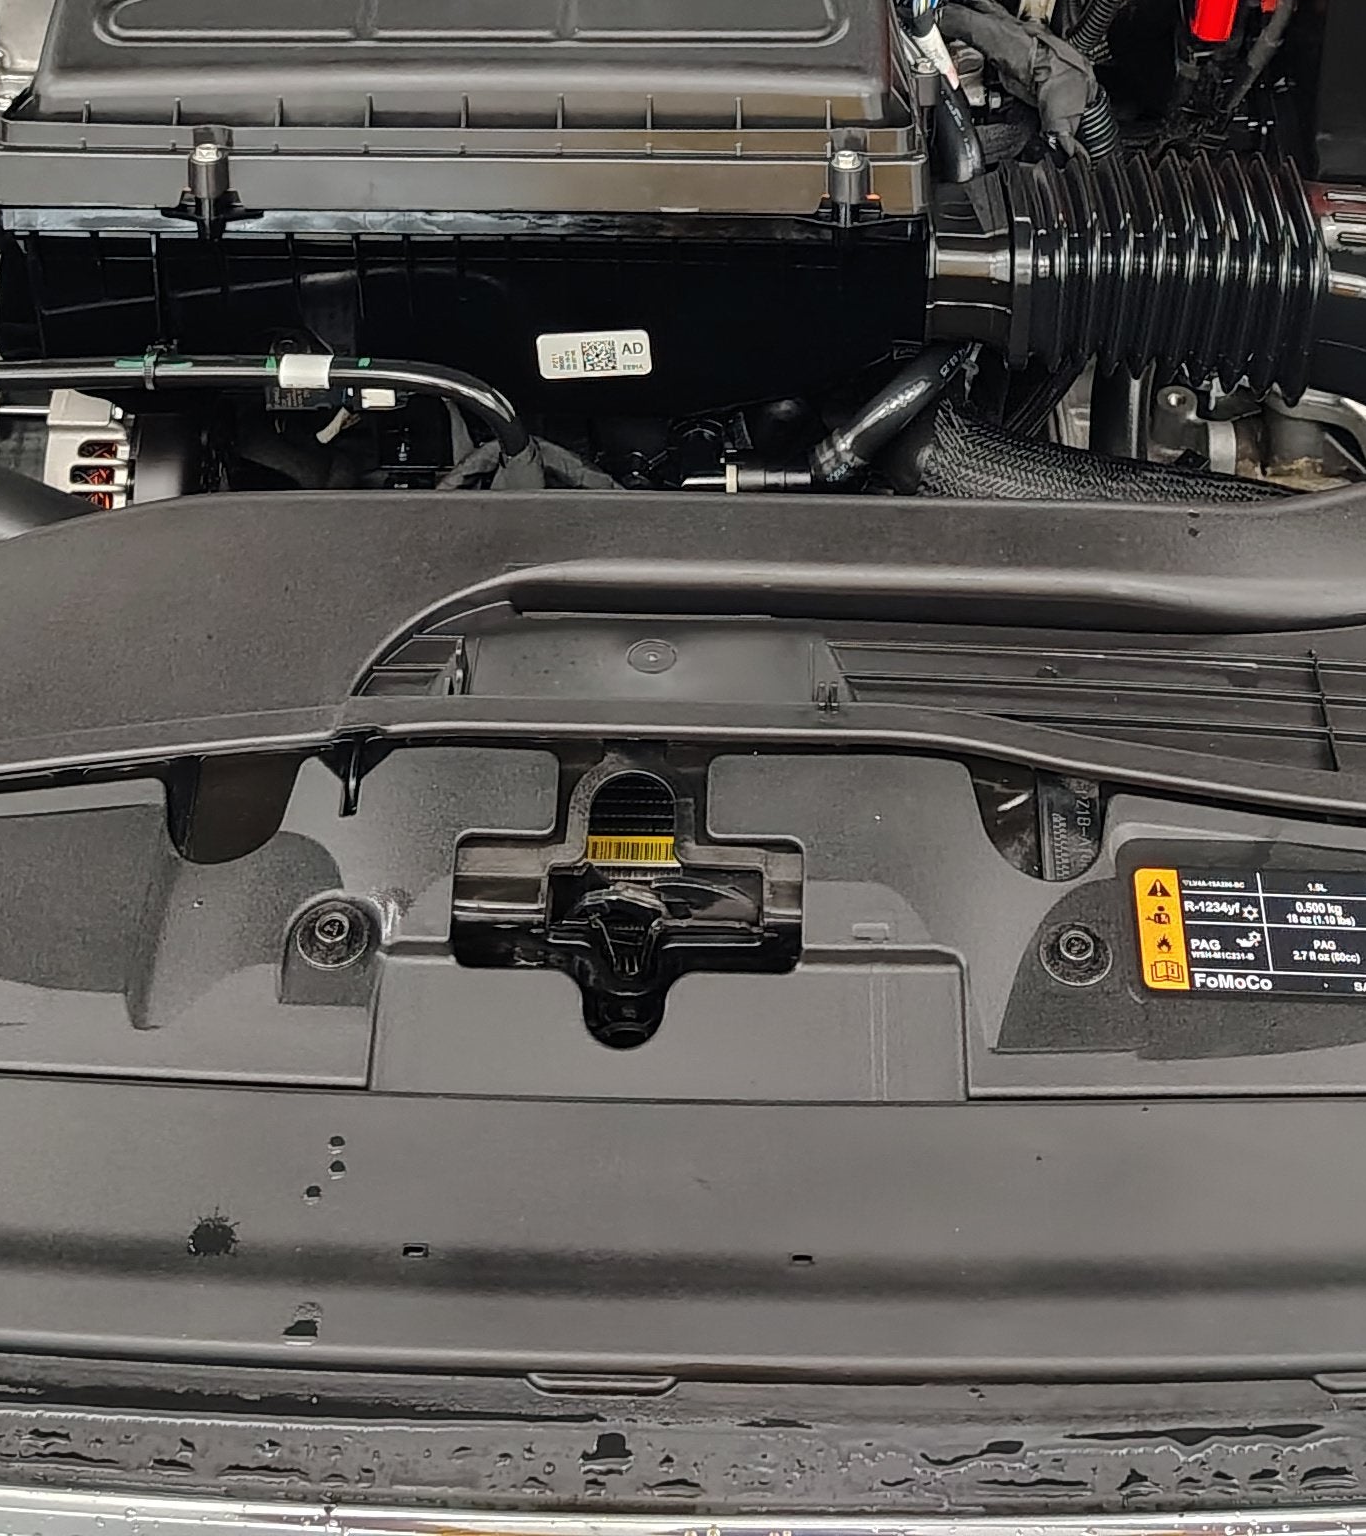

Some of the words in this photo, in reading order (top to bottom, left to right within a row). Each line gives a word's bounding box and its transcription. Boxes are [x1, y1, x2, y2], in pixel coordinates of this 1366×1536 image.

[622, 342, 644, 356] AD
[1185, 900, 1240, 914] R-1234yf
[1296, 901, 1325, 913] 0.500
[1328, 903, 1343, 916] kg
[1300, 915, 1312, 924] oz
[1337, 915, 1355, 927] lbs)
[1191, 938, 1221, 951] PAG
[1313, 940, 1337, 950] PAG
[1293, 951, 1307, 961] 2.7
[1308, 952, 1317, 961] fl
[1318, 954, 1330, 962] oz
[1194, 973, 1273, 990] FoMoCo
